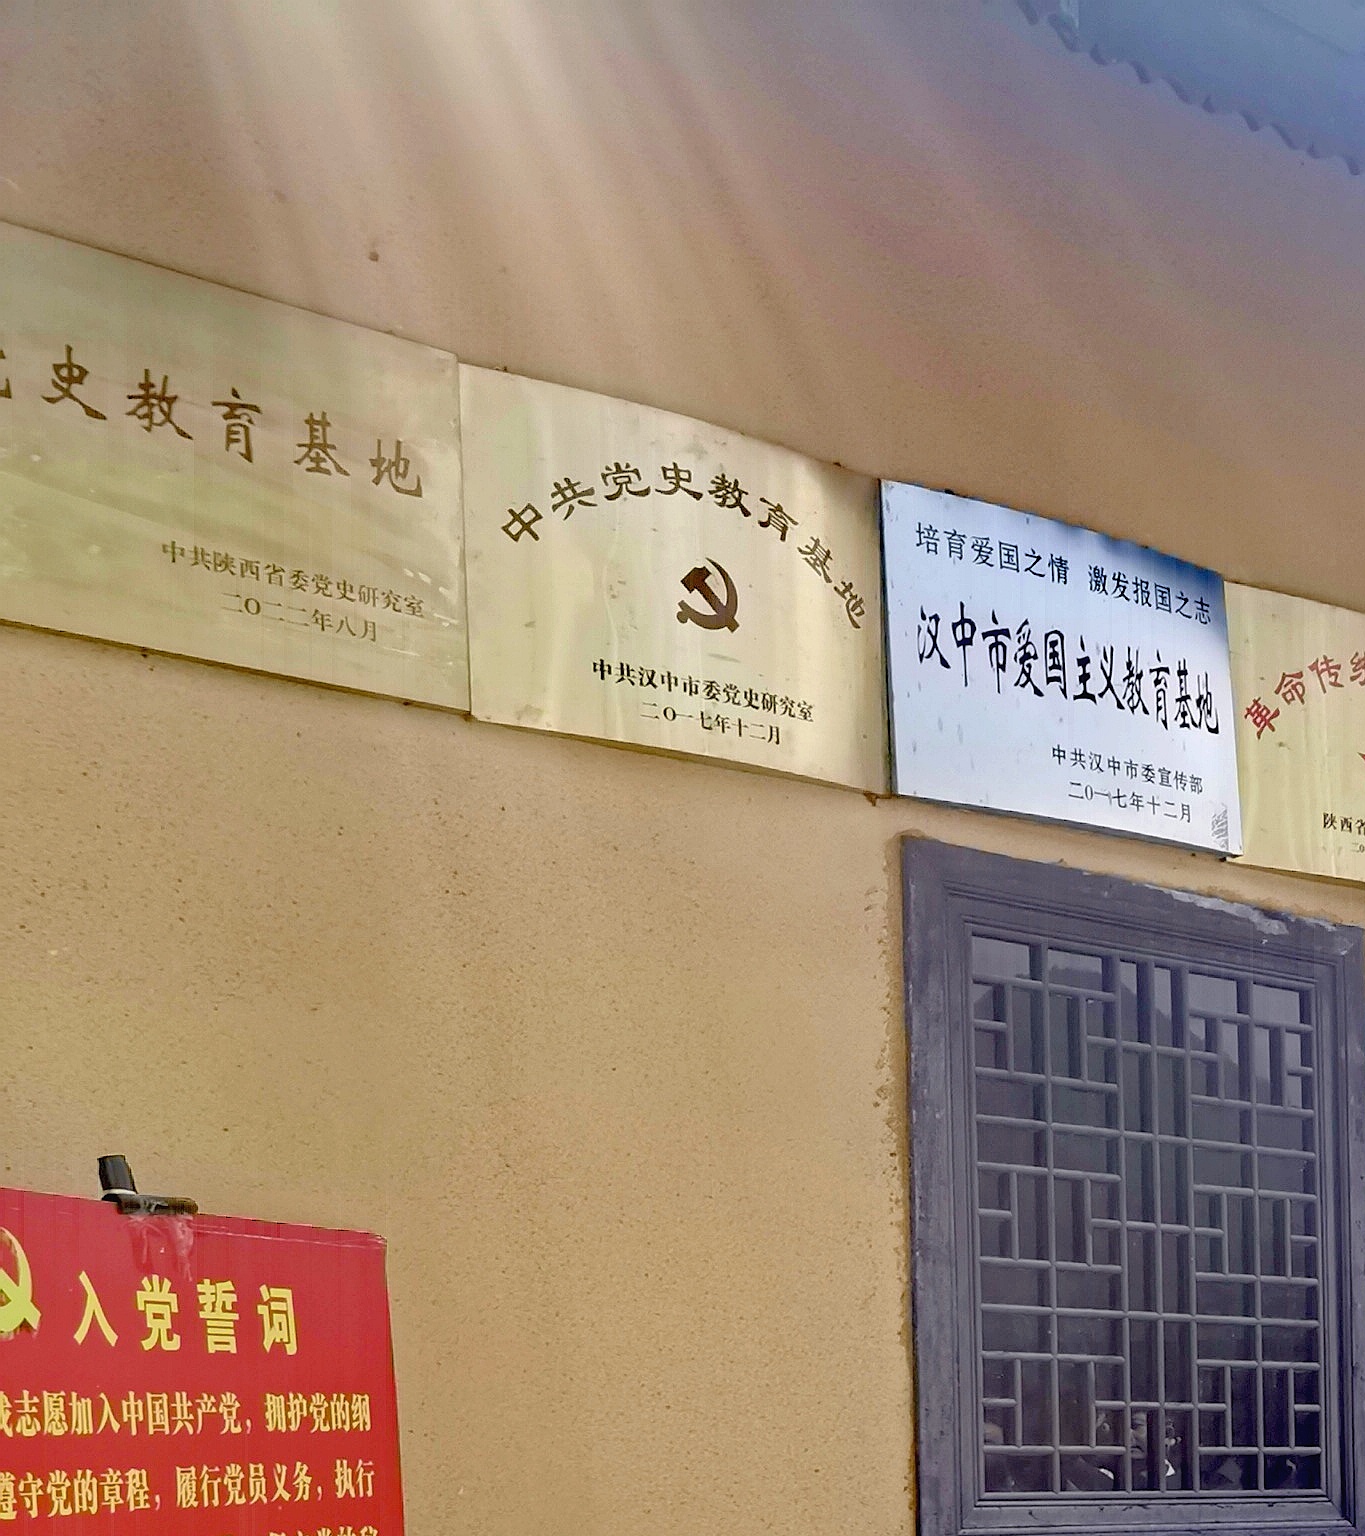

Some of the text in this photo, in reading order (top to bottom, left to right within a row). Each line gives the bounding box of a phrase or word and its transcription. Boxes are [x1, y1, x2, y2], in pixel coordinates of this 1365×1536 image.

[162, 540, 425, 619] 中共陕西省委党史研究室
[501, 462, 867, 629] 中共党史教育基地
[915, 522, 1212, 626] 培育爱国之情 激发报国之志
[592, 658, 815, 723] 中共汉中市委党史研究室
[916, 601, 1220, 735] 汉中市爱国主义教育基地
[1052, 744, 1203, 795] 中共汉中市委宣传部
[73, 1270, 298, 1356] 入党誓词
